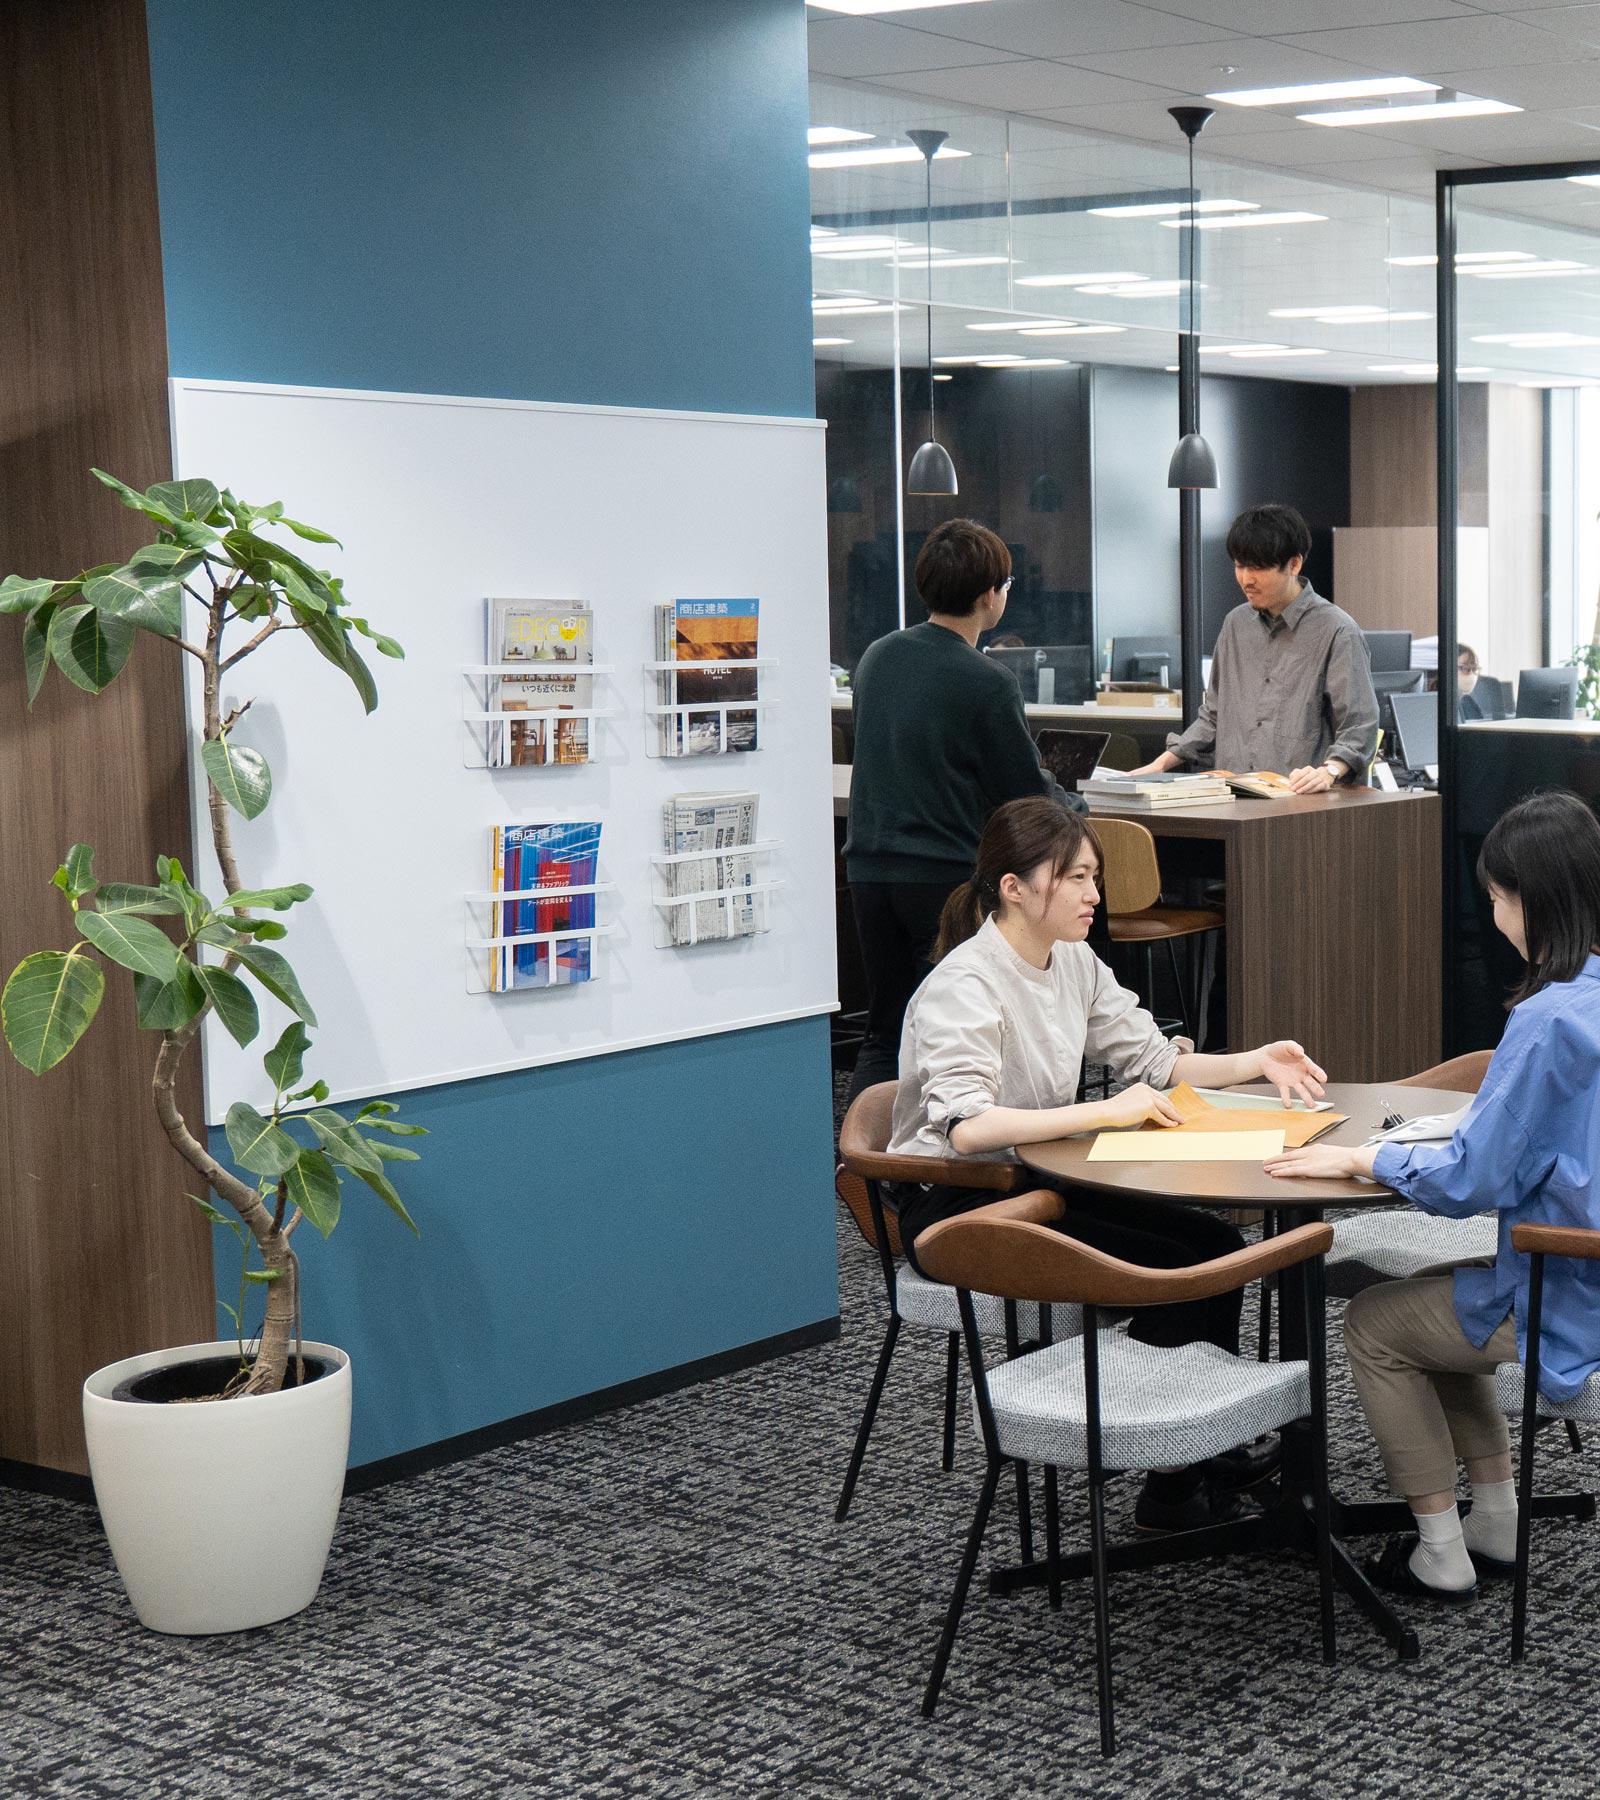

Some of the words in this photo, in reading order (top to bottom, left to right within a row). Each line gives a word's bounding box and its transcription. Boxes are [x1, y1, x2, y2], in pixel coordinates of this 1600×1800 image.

[680, 603, 728, 614] 商店建築
[519, 617, 587, 641] DECR
[522, 684, 576, 693] いつも近くに北欧
[509, 828, 565, 841] 商店建築
